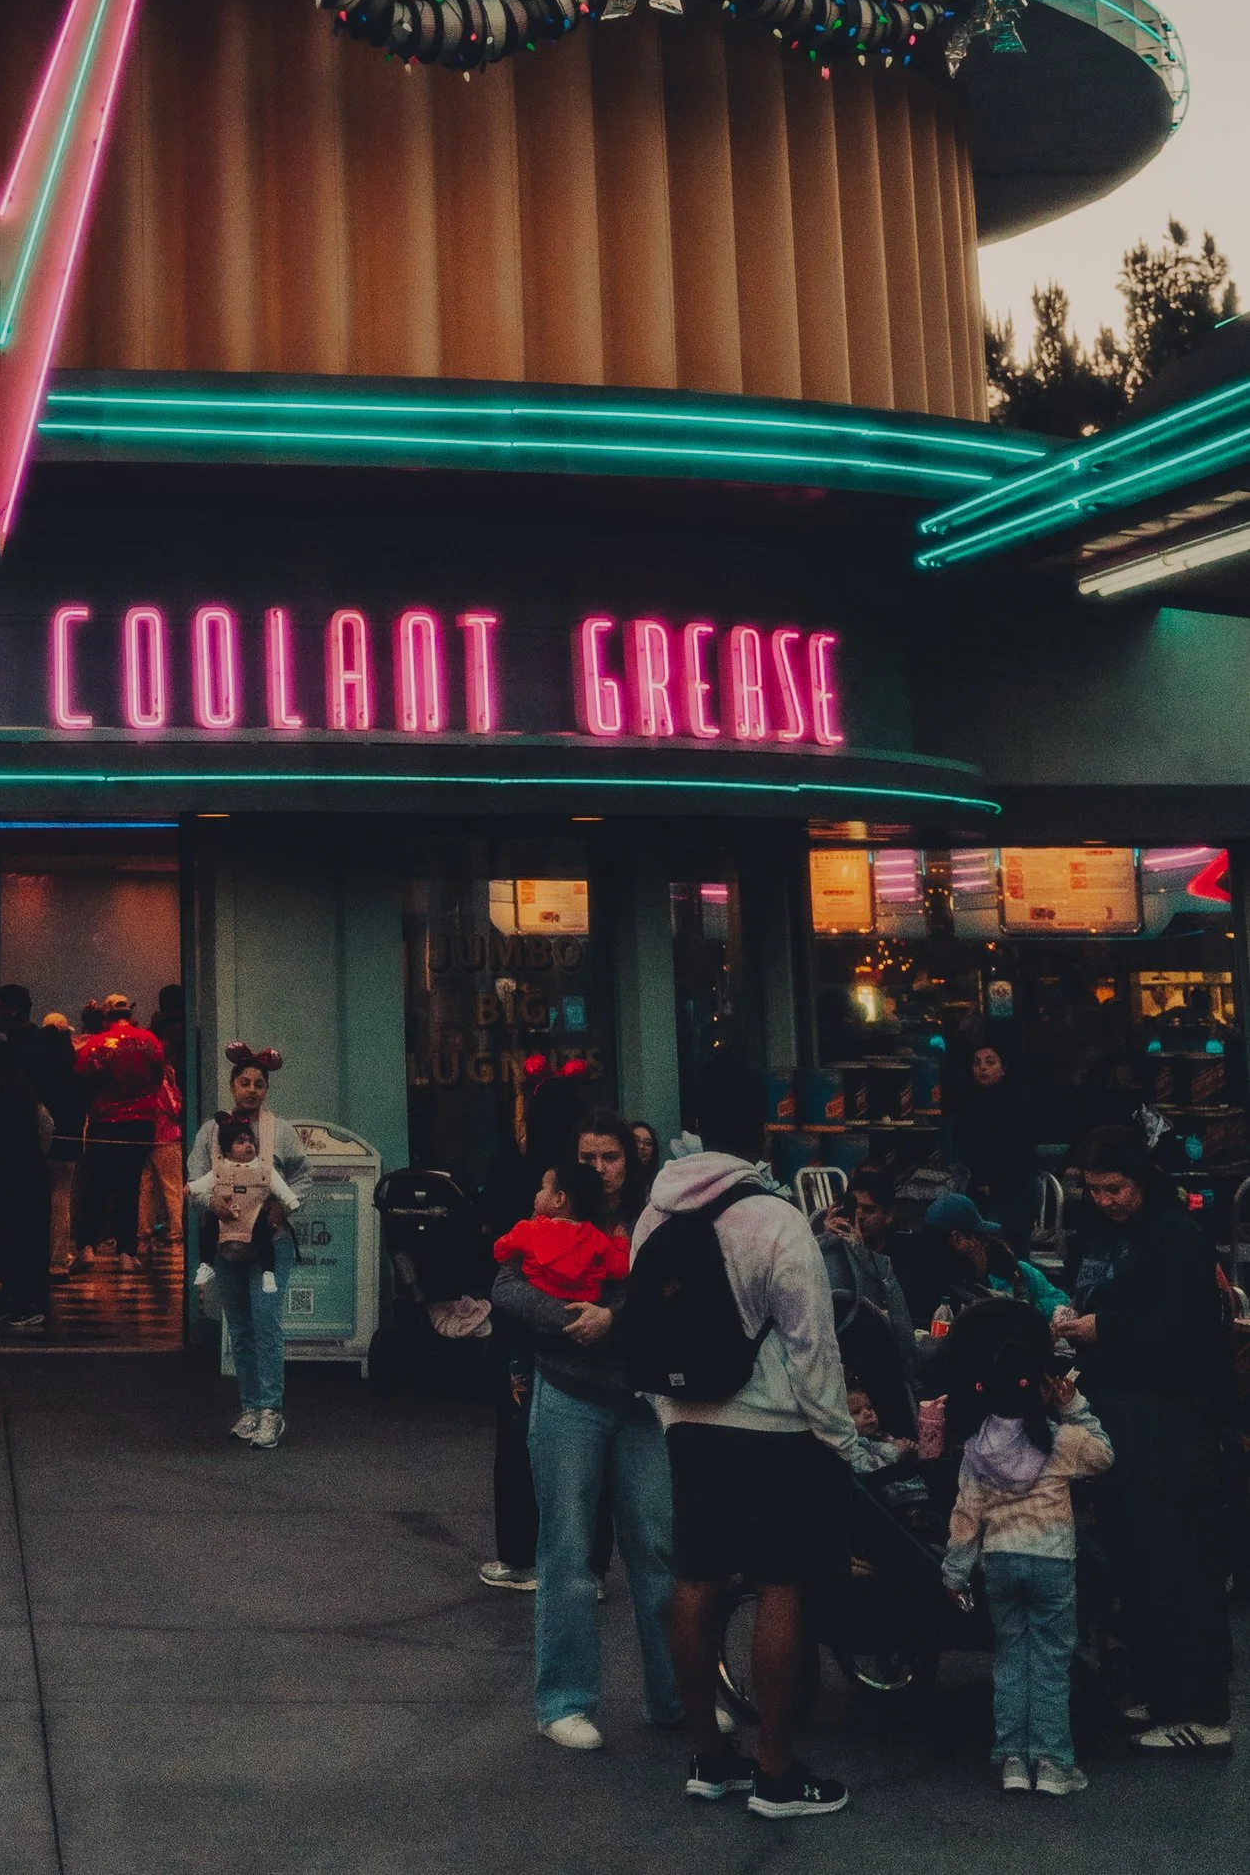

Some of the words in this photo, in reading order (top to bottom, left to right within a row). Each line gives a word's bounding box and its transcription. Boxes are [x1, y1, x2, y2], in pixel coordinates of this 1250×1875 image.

[54, 606, 497, 732] COOLANT
[578, 617, 844, 746] GREASE
[476, 991, 548, 1029] BIG
